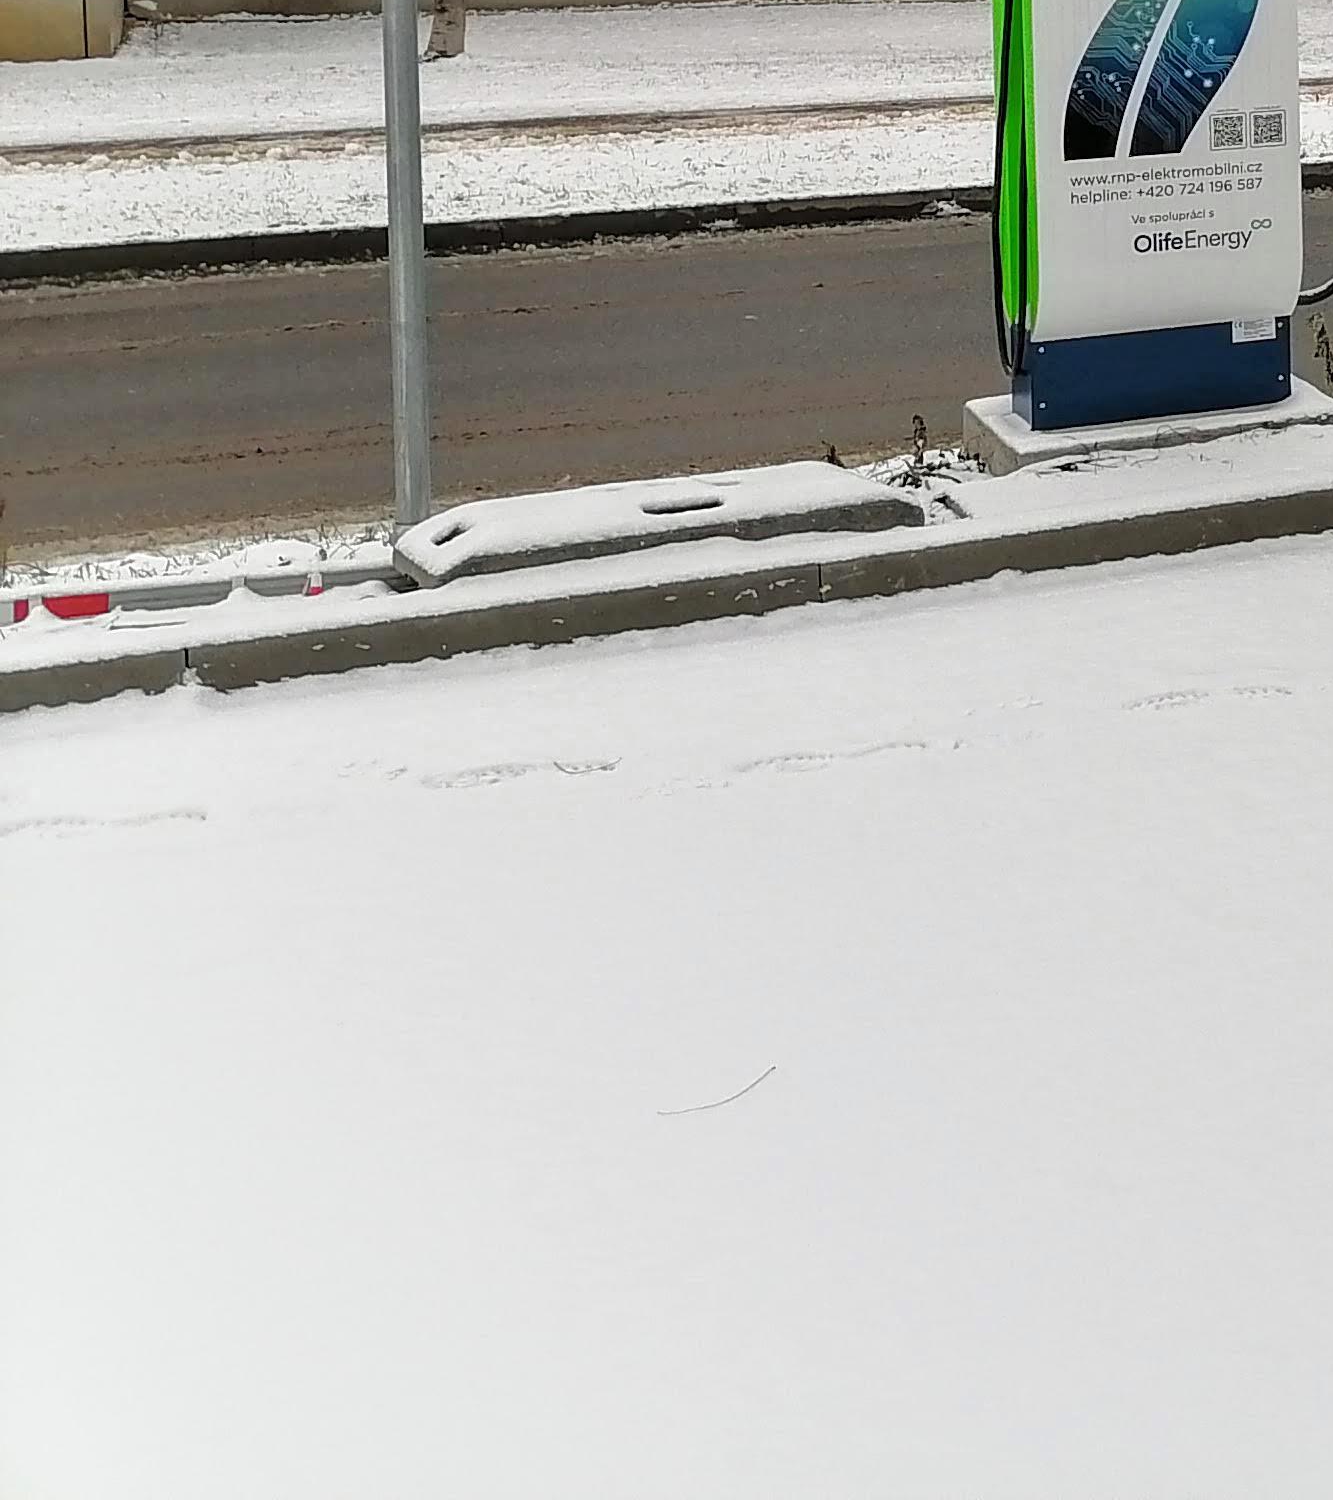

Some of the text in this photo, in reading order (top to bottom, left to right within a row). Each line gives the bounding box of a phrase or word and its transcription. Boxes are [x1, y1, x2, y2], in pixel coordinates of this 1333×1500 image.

[1070, 177, 1263, 205] helpline: +420 724 196 587
[1131, 214, 1146, 224] Ve
[1208, 210, 1215, 218] s
[1134, 230, 1253, 253] OlifeEnergy
